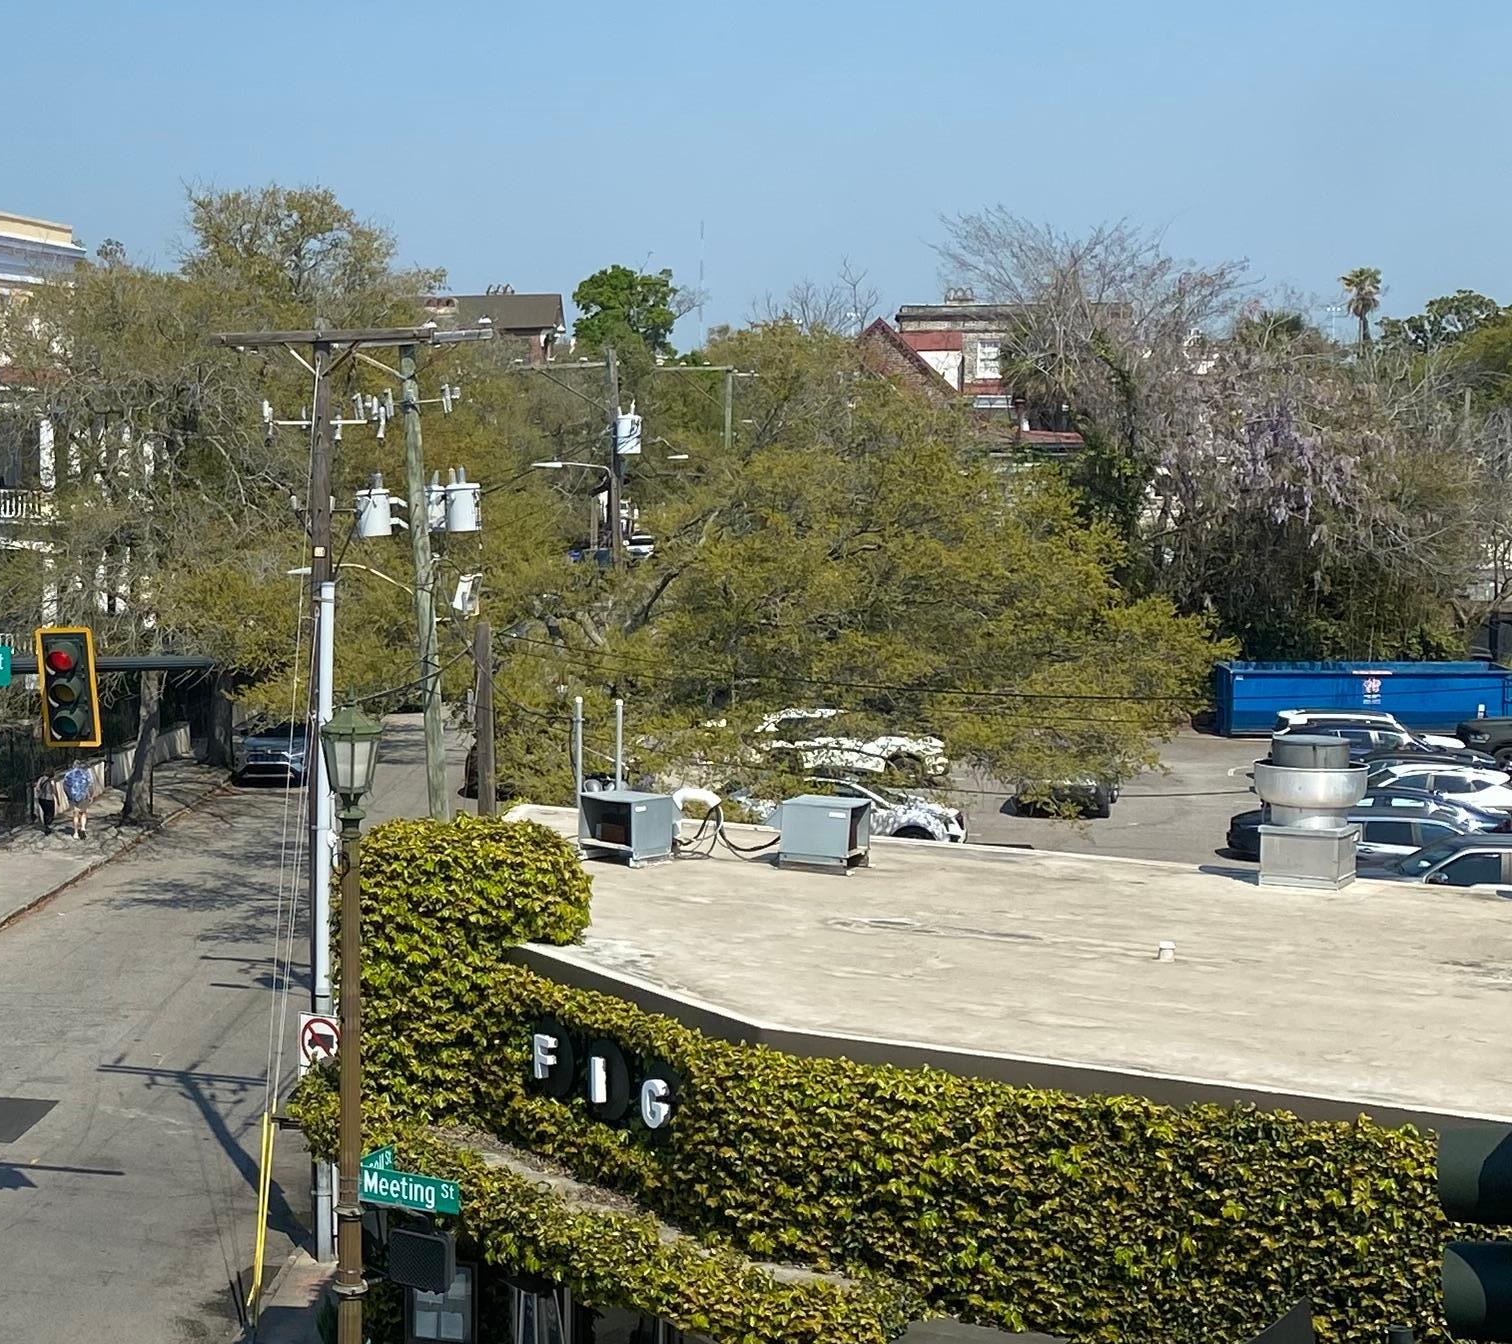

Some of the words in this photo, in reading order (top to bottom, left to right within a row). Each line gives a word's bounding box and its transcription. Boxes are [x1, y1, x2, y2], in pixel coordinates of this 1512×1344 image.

[533, 1033, 671, 1130] FIG
[363, 1169, 436, 1209] Meeting
[440, 1183, 455, 1200] St
